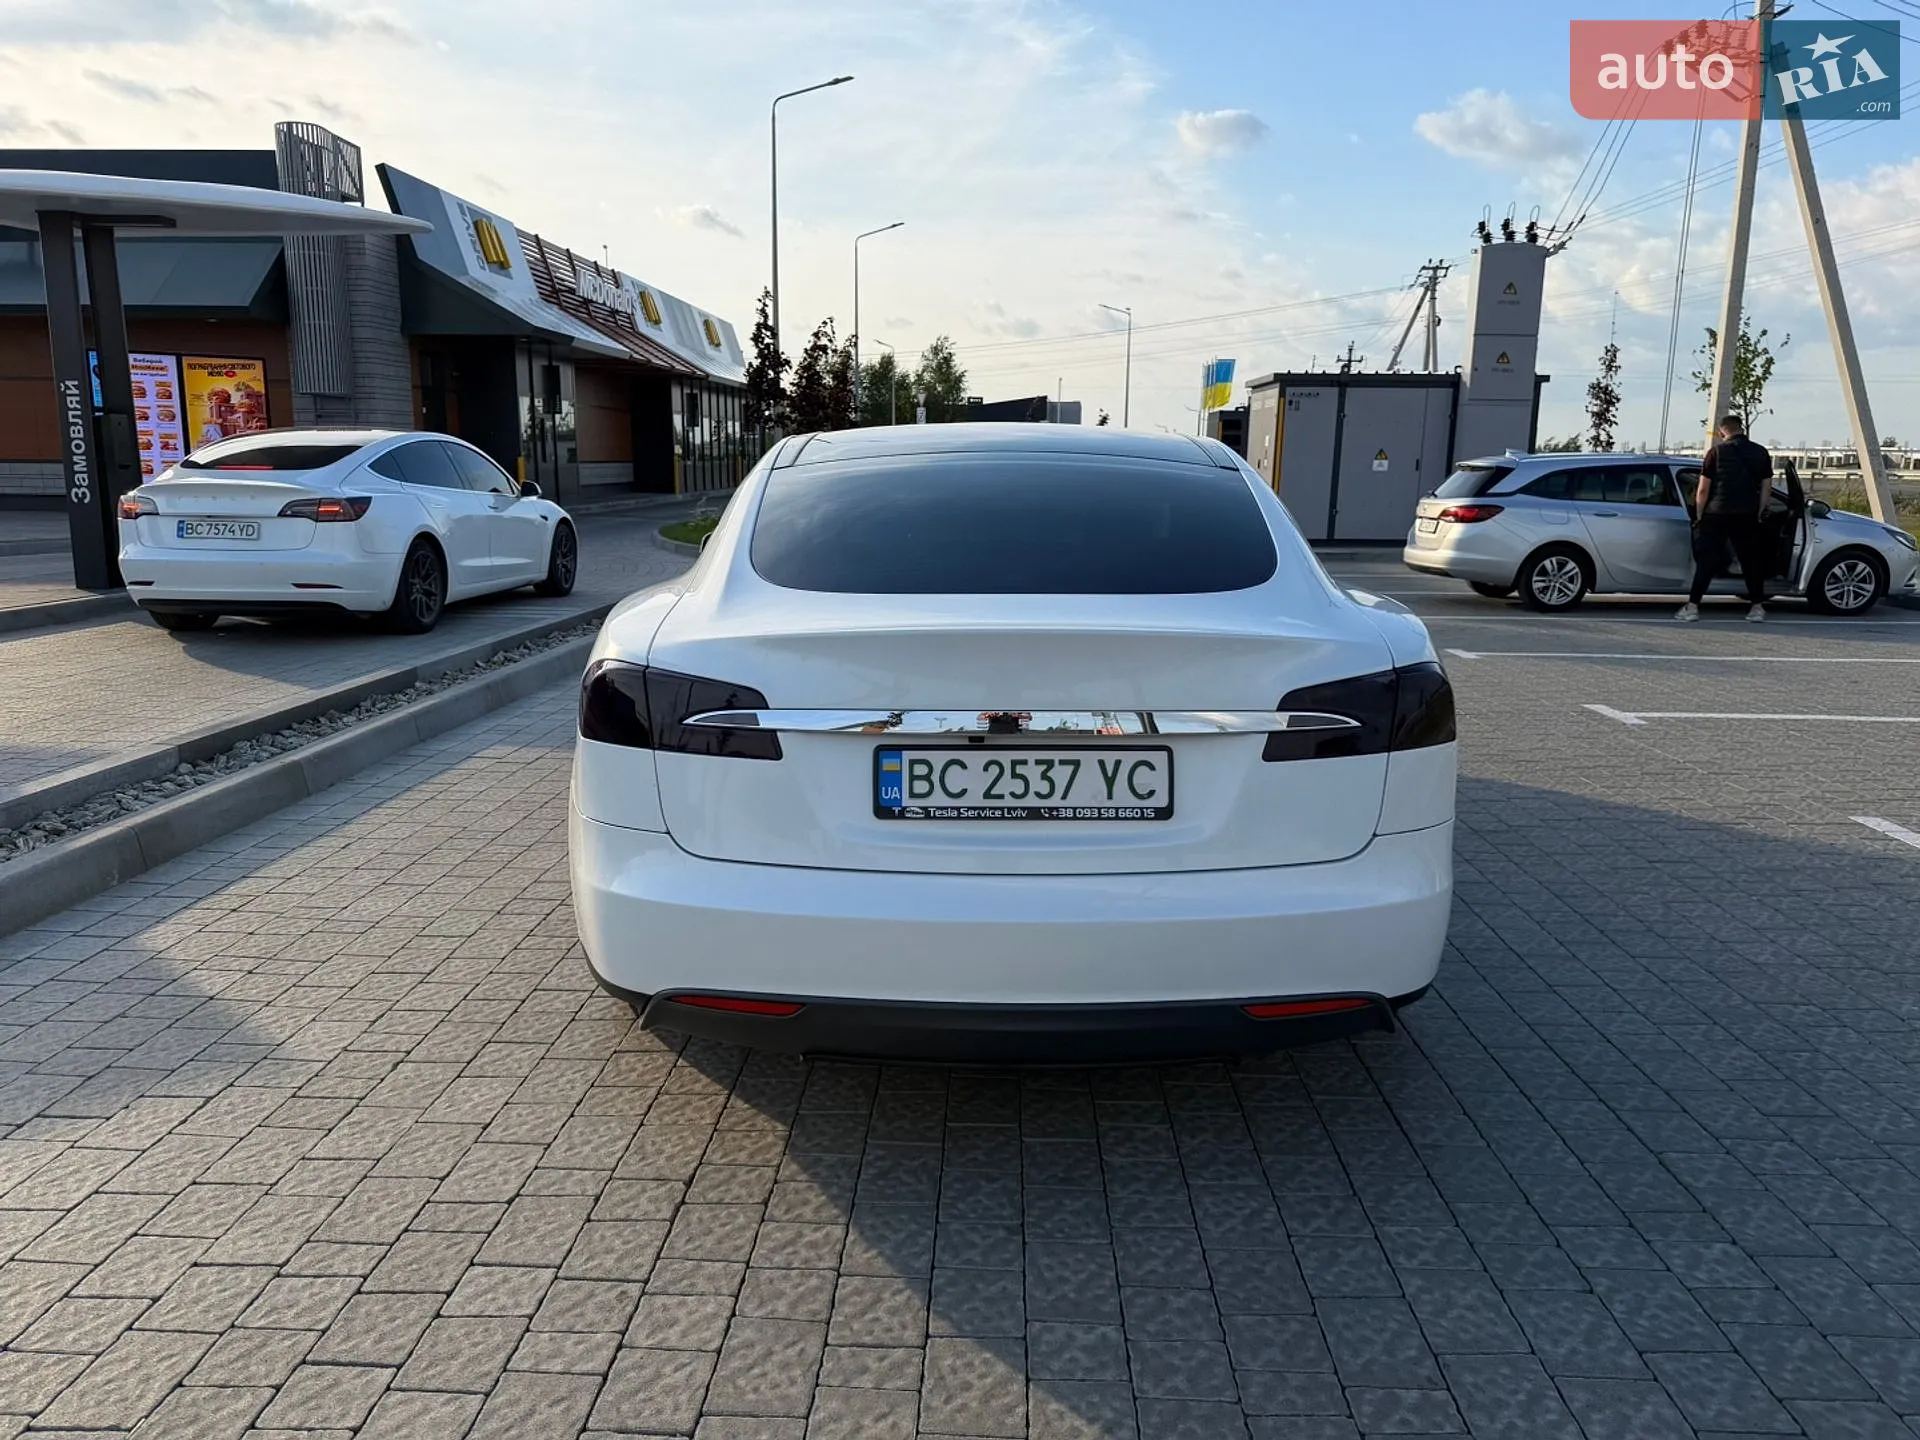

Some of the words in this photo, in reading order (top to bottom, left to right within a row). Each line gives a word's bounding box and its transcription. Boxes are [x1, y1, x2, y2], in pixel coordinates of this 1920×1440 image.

[60, 379, 91, 504] Замовляй
[185, 522, 204, 536] BC
[206, 523, 236, 537] 7574
[238, 524, 256, 537] YD
[908, 759, 968, 800] BC
[982, 759, 1081, 800] 2537
[1097, 759, 1157, 800] YC
[881, 787, 900, 800] UA
[928, 807, 958, 818] Tesla
[960, 807, 1002, 818] Service
[1004, 807, 1028, 818] Lviv
[1052, 808, 1073, 818] +38
[1076, 808, 1098, 818] 093
